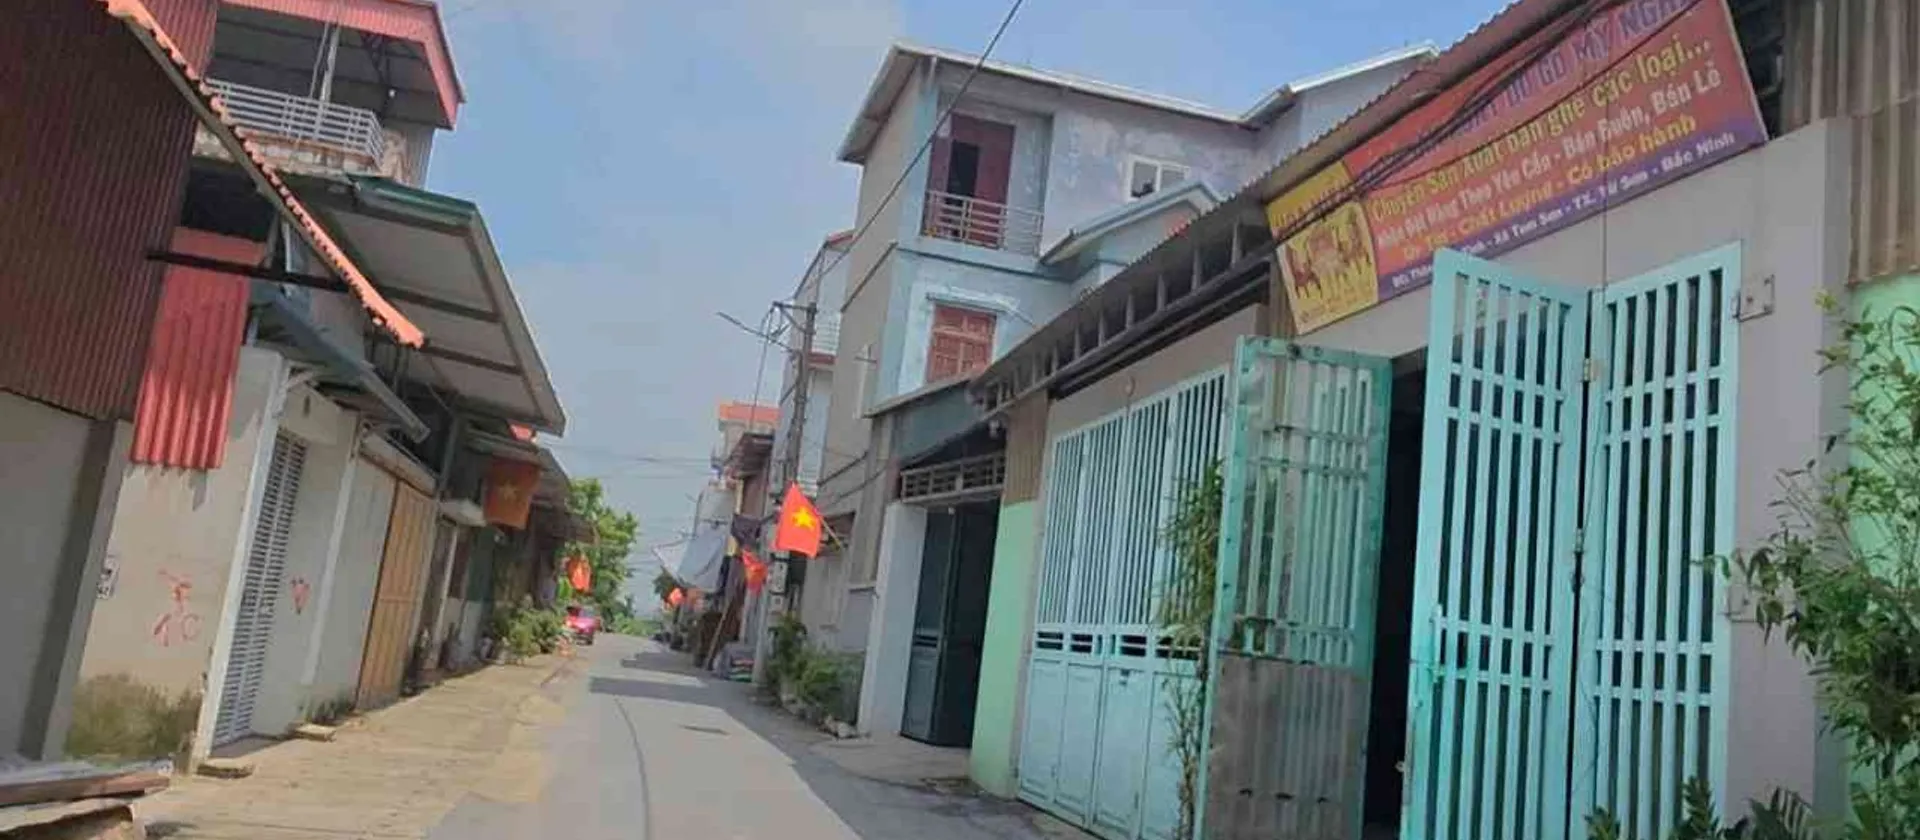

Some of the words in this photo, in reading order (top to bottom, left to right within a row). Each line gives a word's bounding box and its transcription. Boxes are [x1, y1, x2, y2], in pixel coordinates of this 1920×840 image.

[1651, 81, 1692, 114] Bán
[1566, 161, 1593, 184] Có
[1372, 184, 1426, 221] Chuyên
